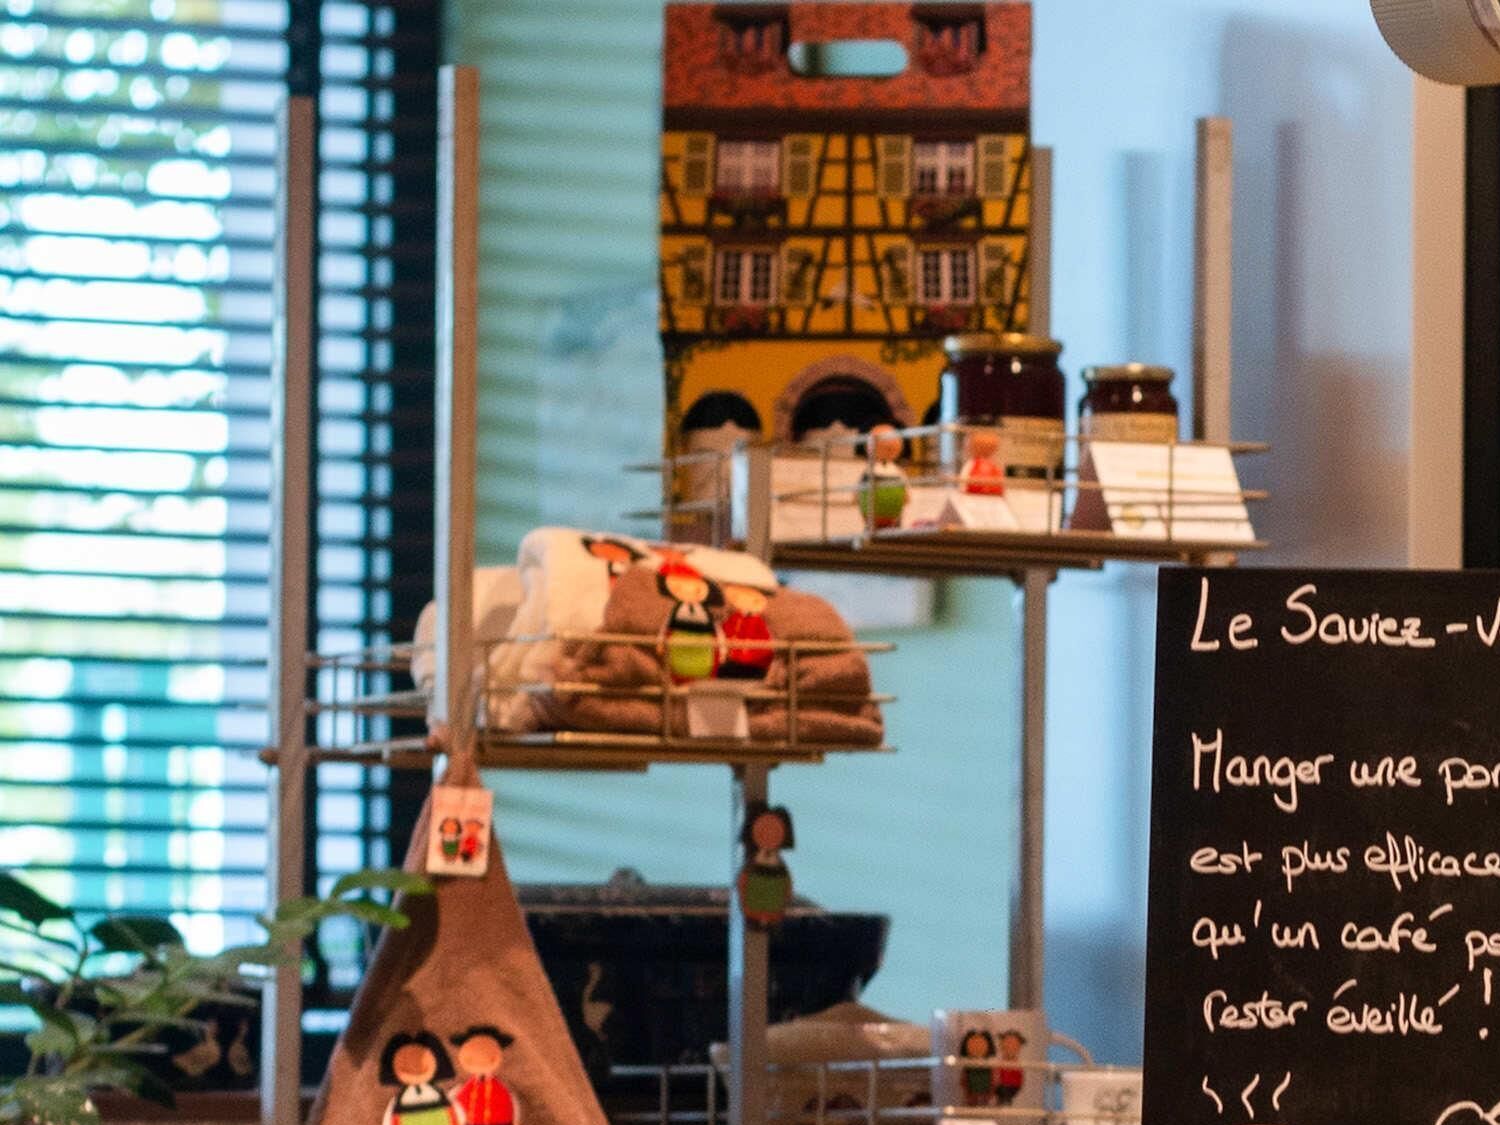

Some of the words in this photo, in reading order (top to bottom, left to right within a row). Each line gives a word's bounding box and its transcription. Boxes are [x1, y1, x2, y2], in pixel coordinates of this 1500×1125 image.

[1191, 577, 1258, 651] Le
[1192, 728, 1334, 812] Manger
[1350, 756, 1421, 786] une
[1190, 841, 1262, 875] est
[1282, 841, 1350, 892] plus
[1341, 904, 1452, 953] café
